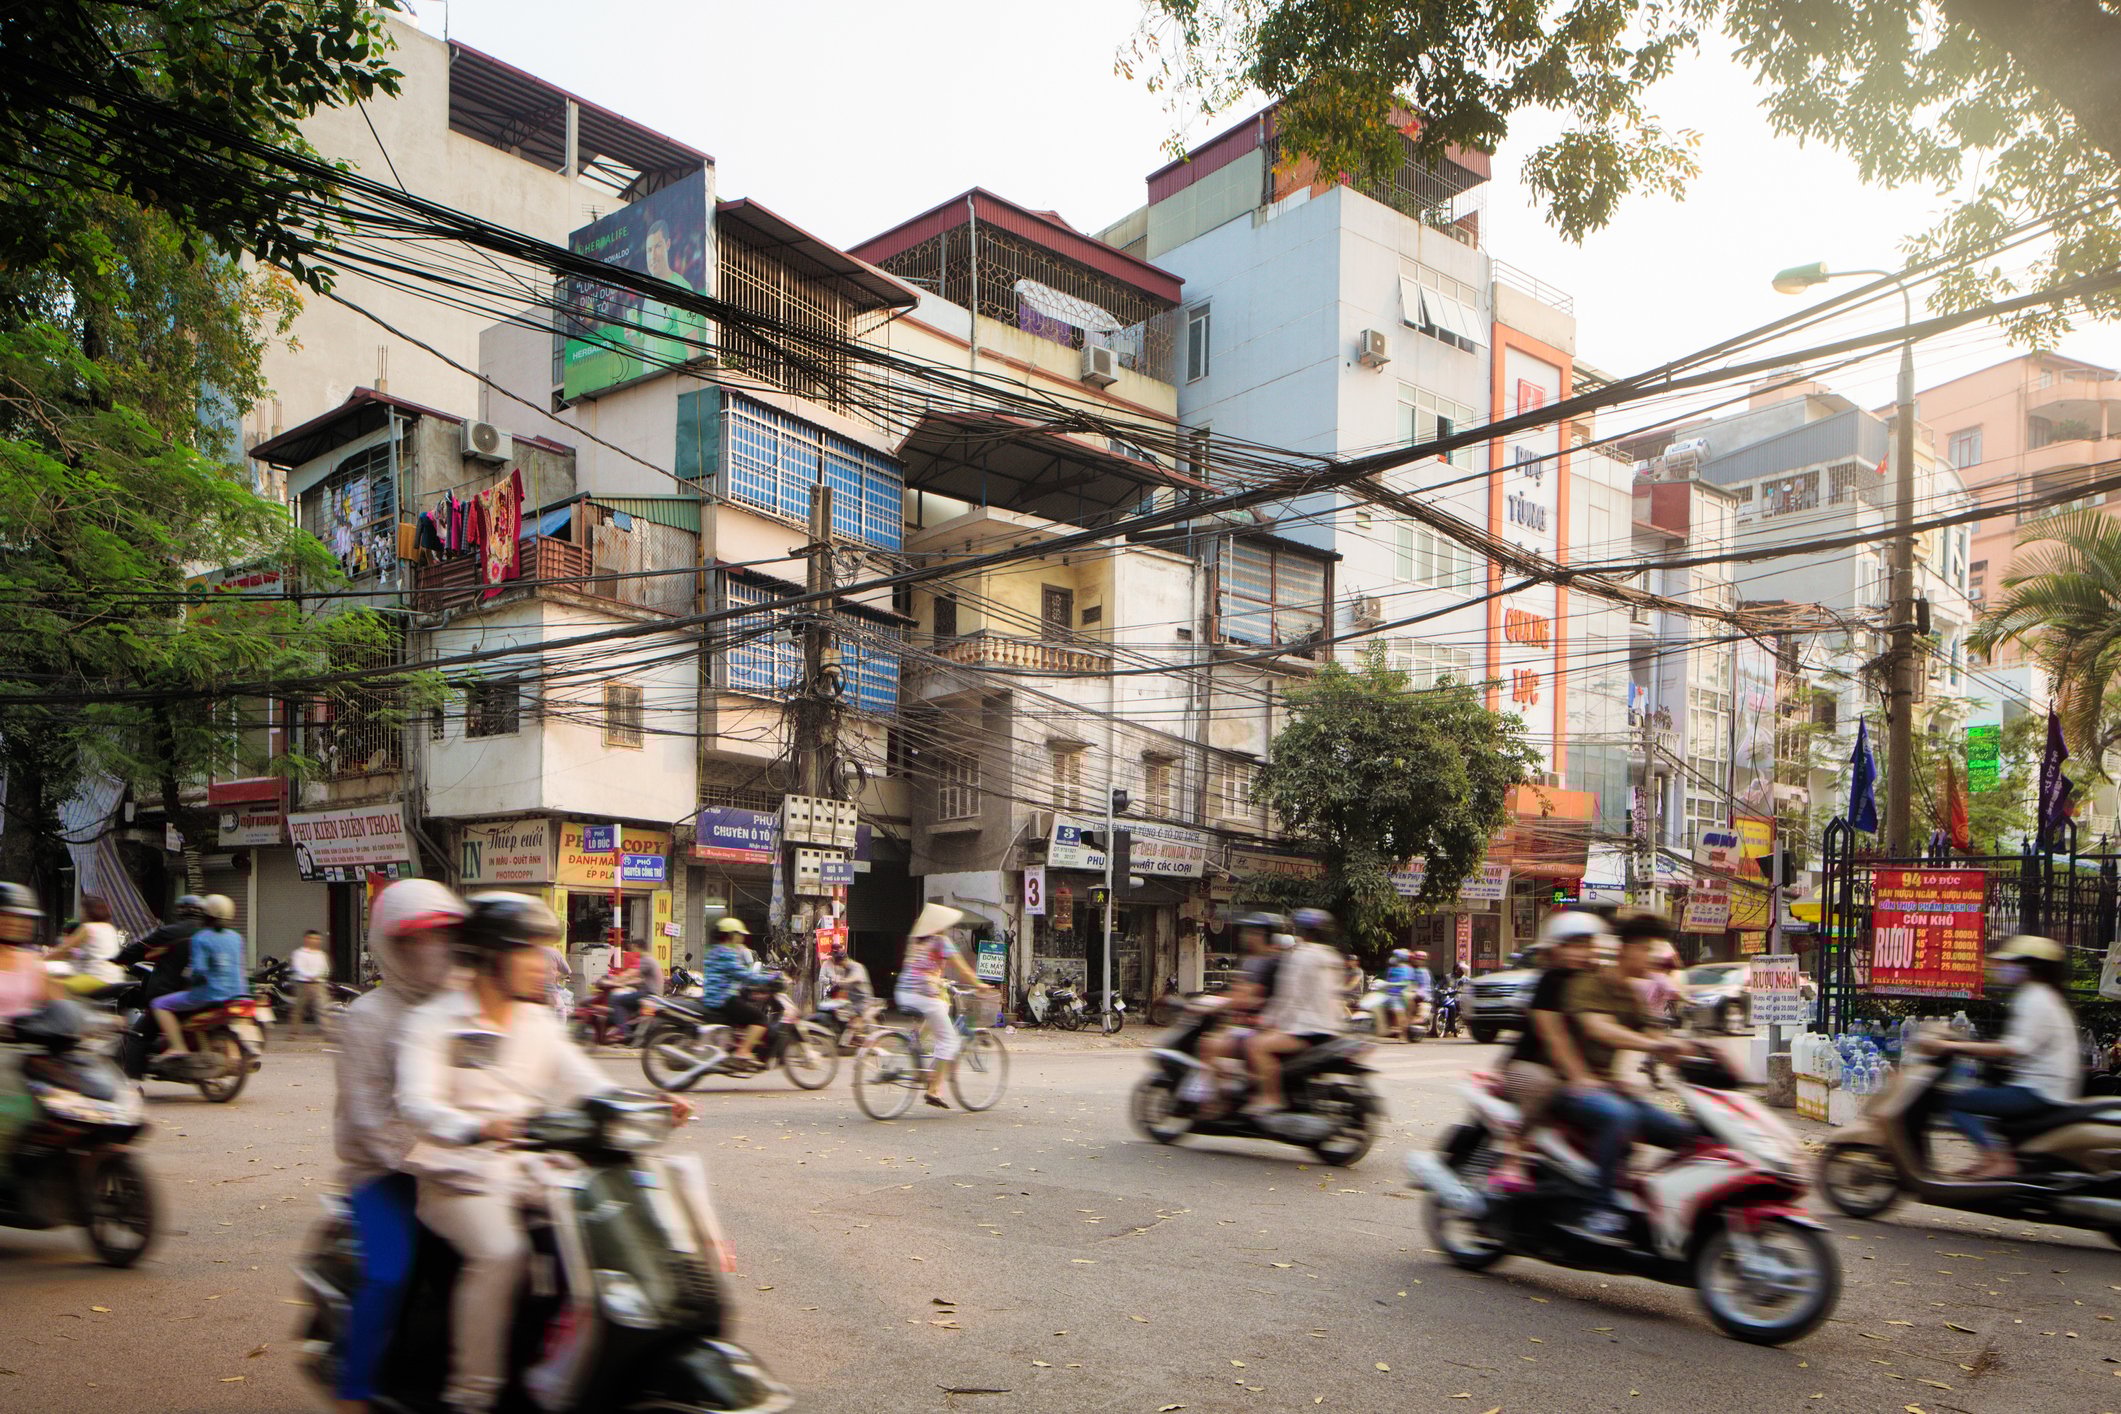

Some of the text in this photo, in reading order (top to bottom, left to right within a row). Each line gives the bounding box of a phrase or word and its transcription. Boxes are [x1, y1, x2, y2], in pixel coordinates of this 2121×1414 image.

[584, 226, 628, 254] HERBALIFE
[754, 815, 773, 829] PHỤ
[713, 825, 770, 841] CHUYÊN Ô TÔ
[1064, 828, 1074, 838] 3
[588, 837, 596, 848] LÒ
[296, 847, 312, 874] 96
[1087, 856, 1104, 868] PHỤ
[1157, 860, 1171, 871] CÁC
[1174, 864, 1192, 875] LOẠI
[1902, 873, 1961, 886] 94 LÒ ĐÚC
[1029, 878, 1039, 906] 3
[1878, 889, 1892, 897] BÁN
[1962, 889, 1983, 900] UỐNG
[659, 899, 666, 913] IN
[1930, 914, 1954, 925] KHÔ
[657, 946, 666, 960] TO
[1874, 924, 1914, 978] RƯỢU
[1753, 966, 1797, 993] RƯỢU NGÂM
